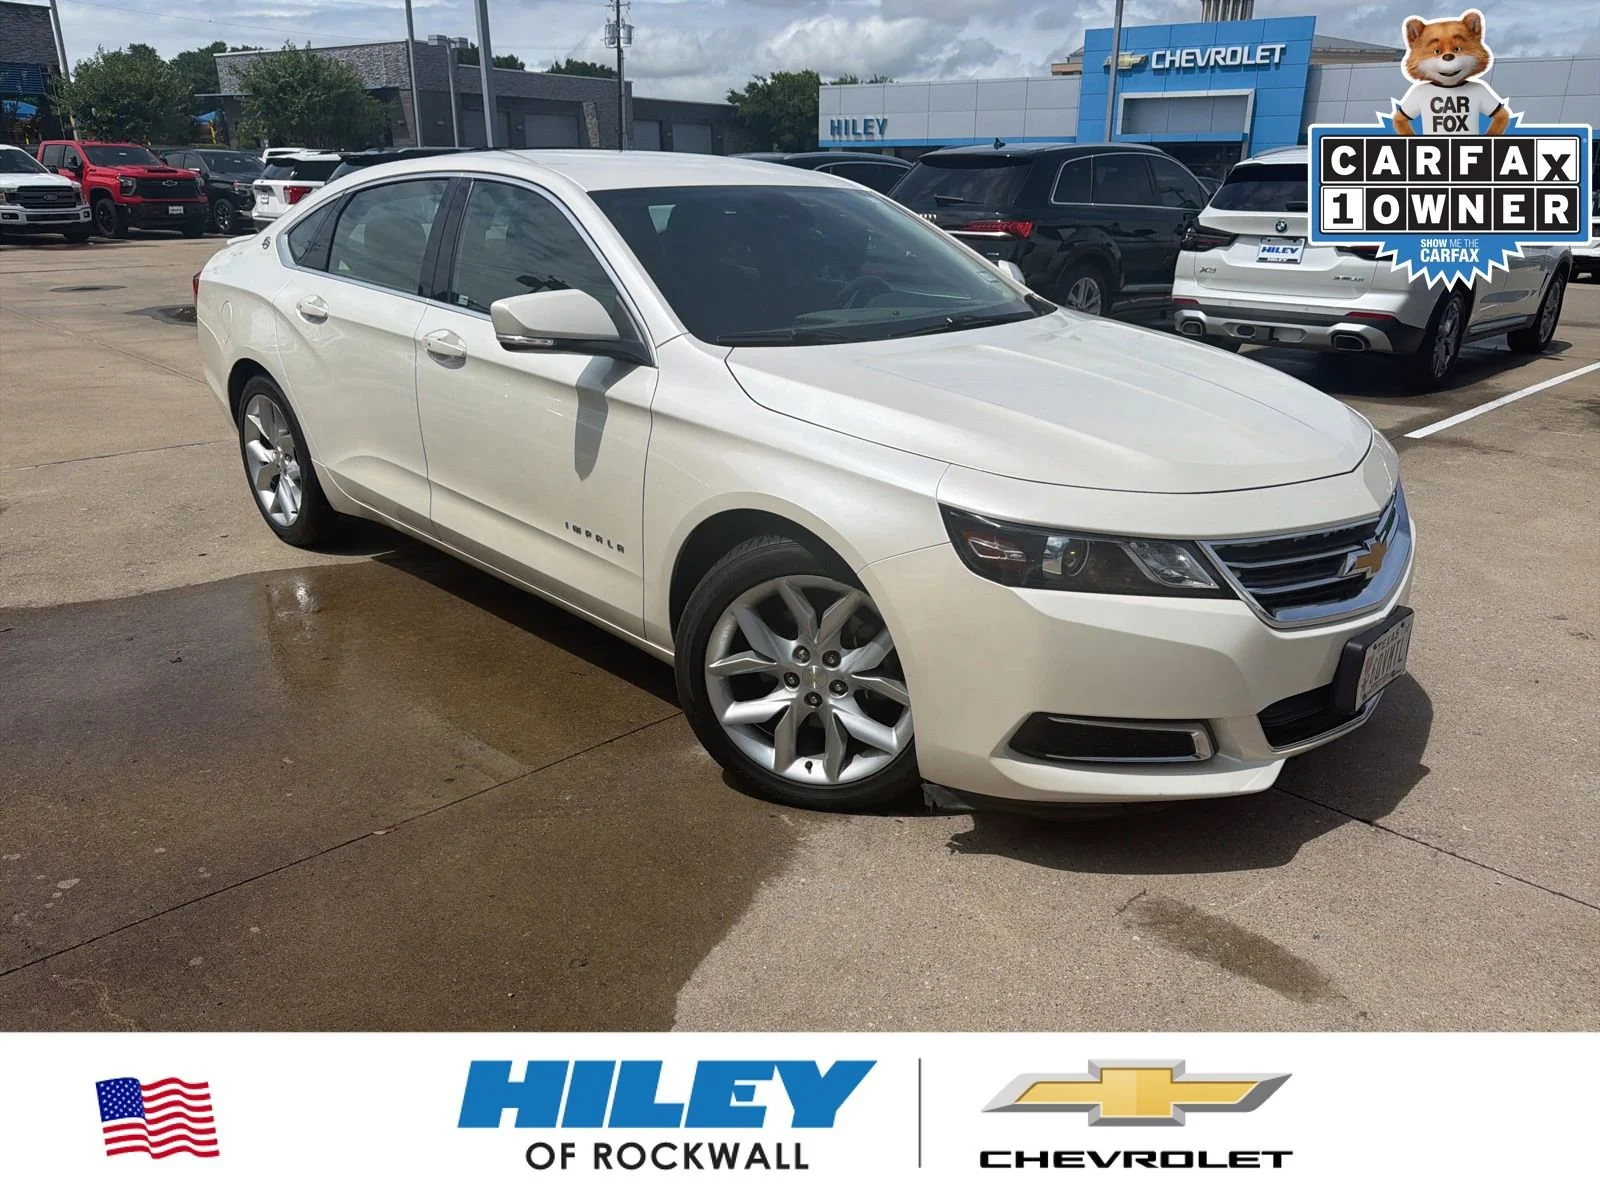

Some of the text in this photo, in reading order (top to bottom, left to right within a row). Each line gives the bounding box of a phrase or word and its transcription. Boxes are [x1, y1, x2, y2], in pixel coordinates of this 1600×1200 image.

[1152, 43, 1286, 69] CHEVROLET
[830, 117, 888, 136] HILEY
[1261, 246, 1299, 254] HILEY
[565, 521, 625, 555] IMPALA
